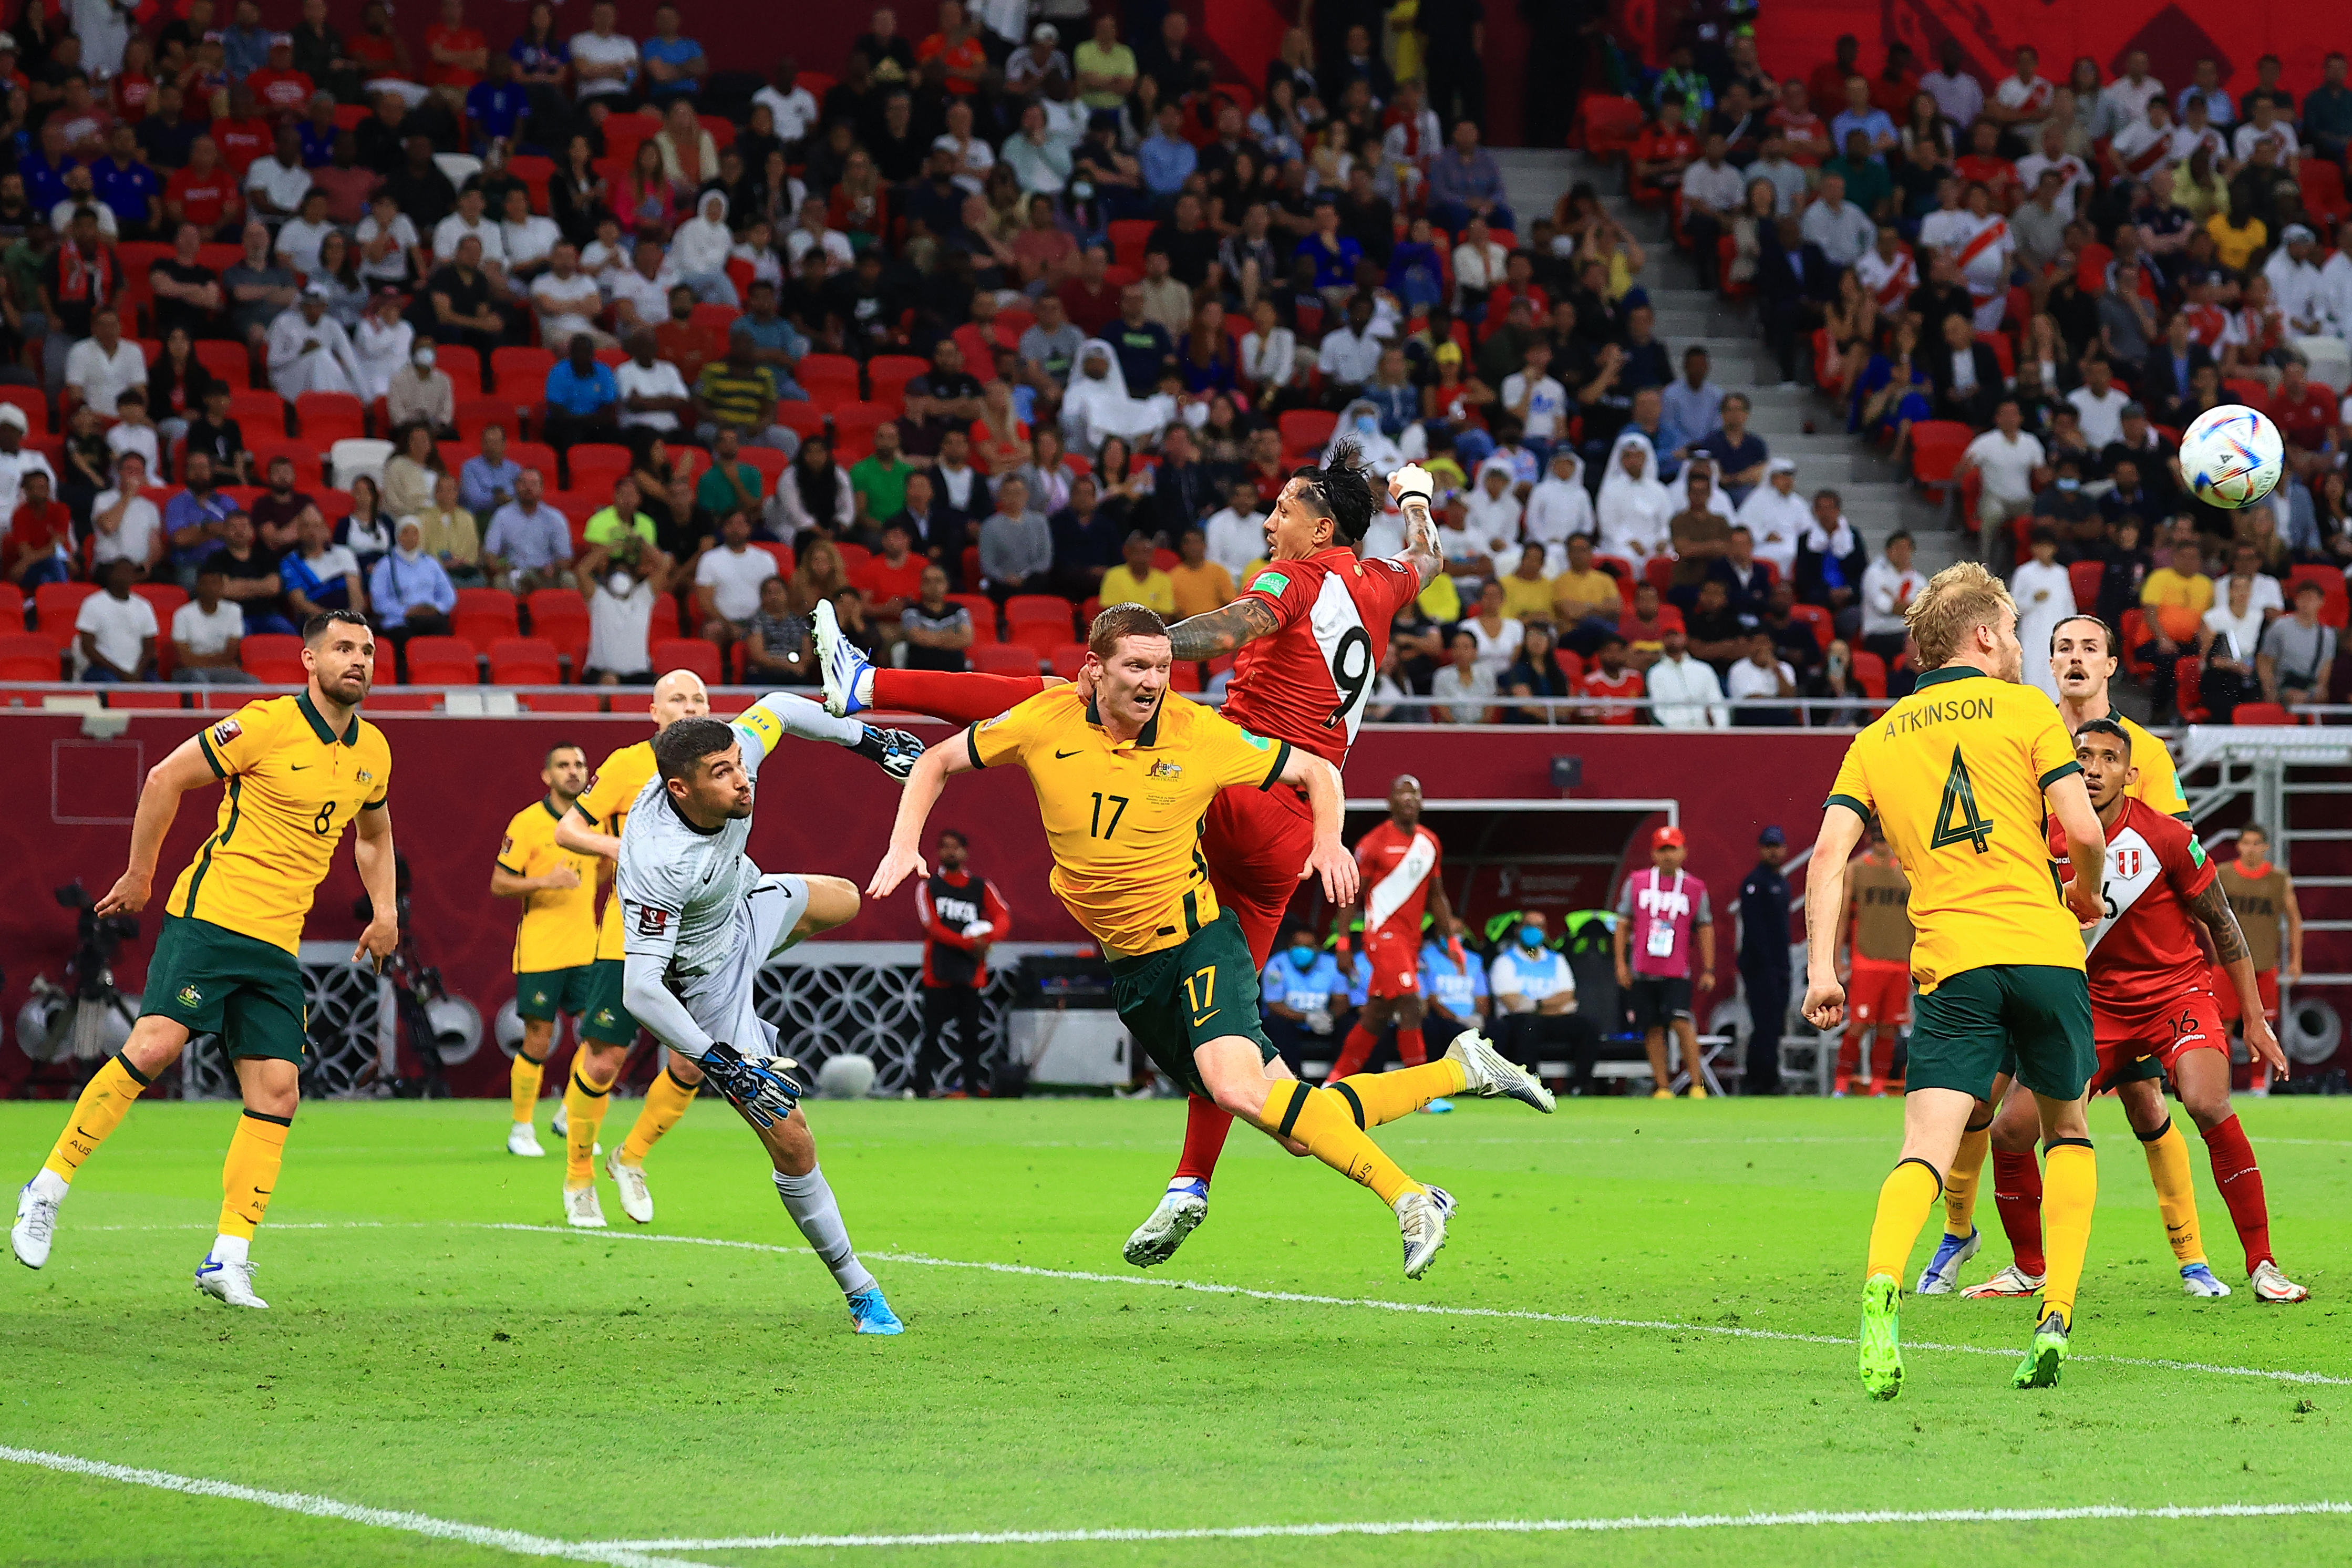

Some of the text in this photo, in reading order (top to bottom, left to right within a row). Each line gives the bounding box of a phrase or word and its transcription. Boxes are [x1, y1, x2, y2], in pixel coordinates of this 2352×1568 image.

[1319, 625, 1373, 731] 9
[1883, 697, 1993, 742] ATKINSON
[314, 801, 336, 834] 8
[1090, 791, 1129, 840] 17
[1930, 740, 1994, 855] 4
[1183, 965, 1216, 1013] 17
[2167, 1008, 2199, 1040] 16
[69, 1140, 92, 1156] AUS
[2171, 1233, 2193, 1244] AUS
